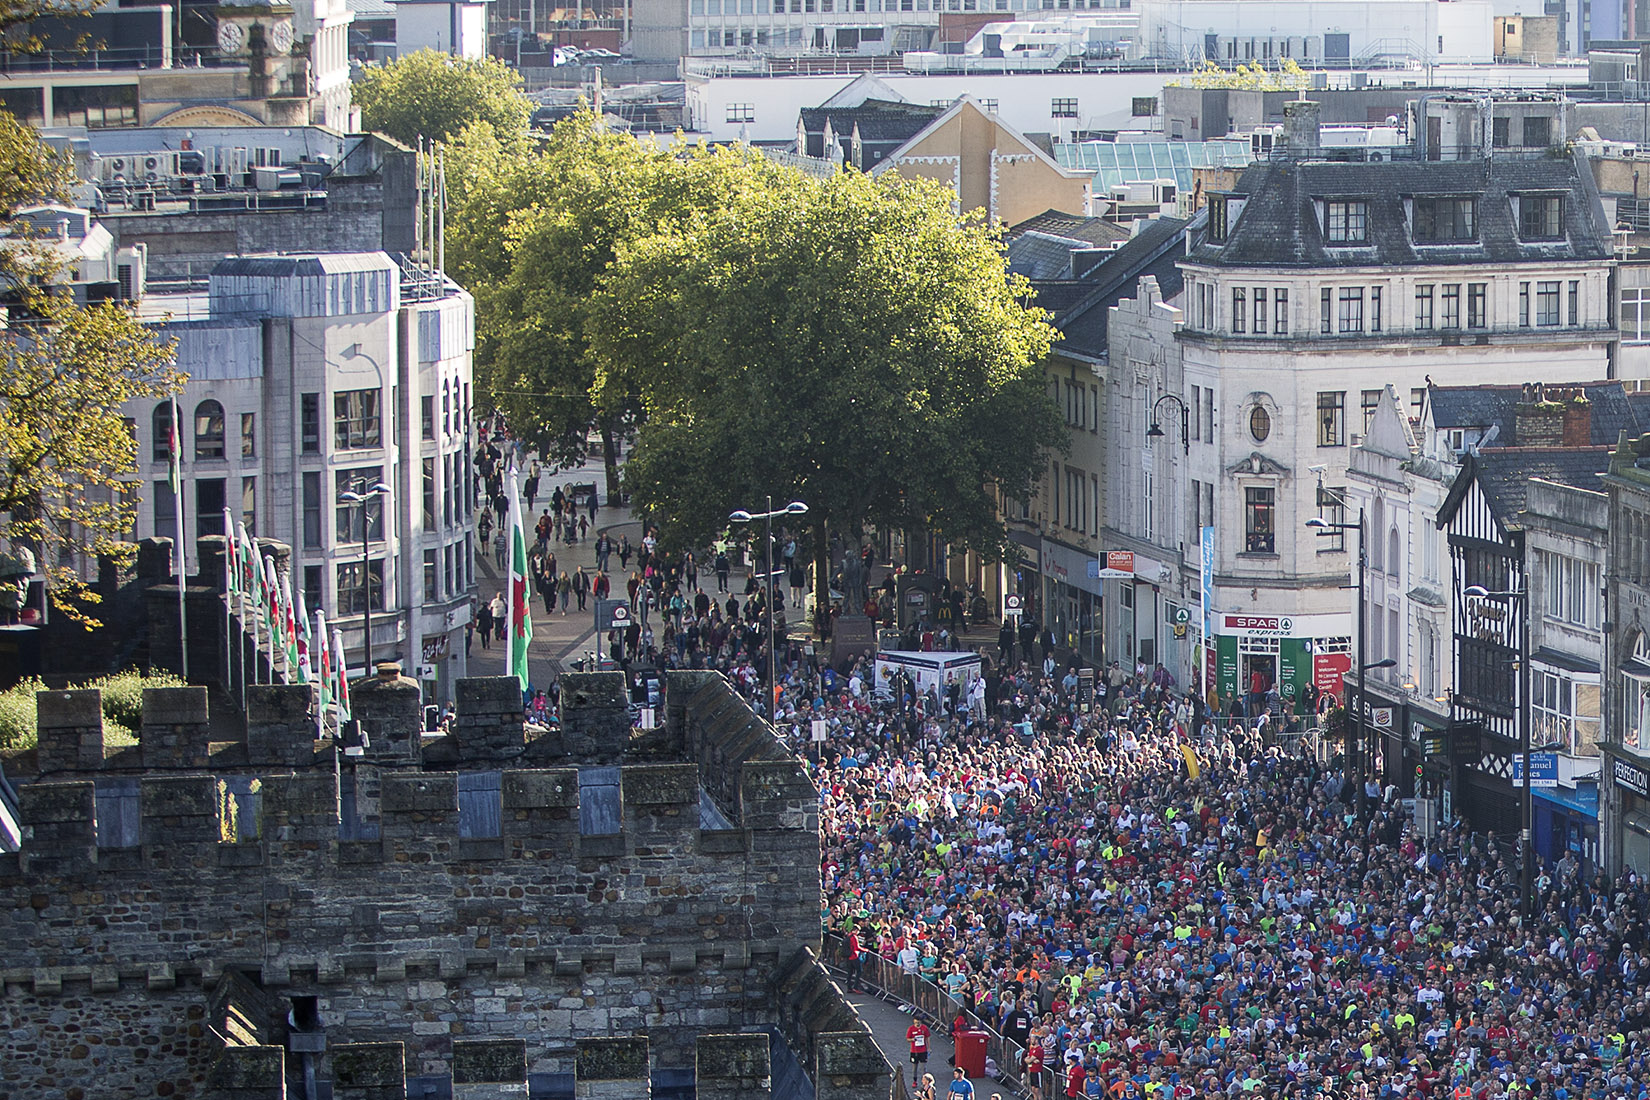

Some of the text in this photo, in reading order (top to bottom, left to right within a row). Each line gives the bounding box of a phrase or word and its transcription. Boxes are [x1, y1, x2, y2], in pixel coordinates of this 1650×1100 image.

[1110, 553, 1132, 561] Calan
[1237, 618, 1278, 628] SPAR
[1518, 760, 1552, 769] eanuel
[1615, 761, 1648, 789] PERFECTION
